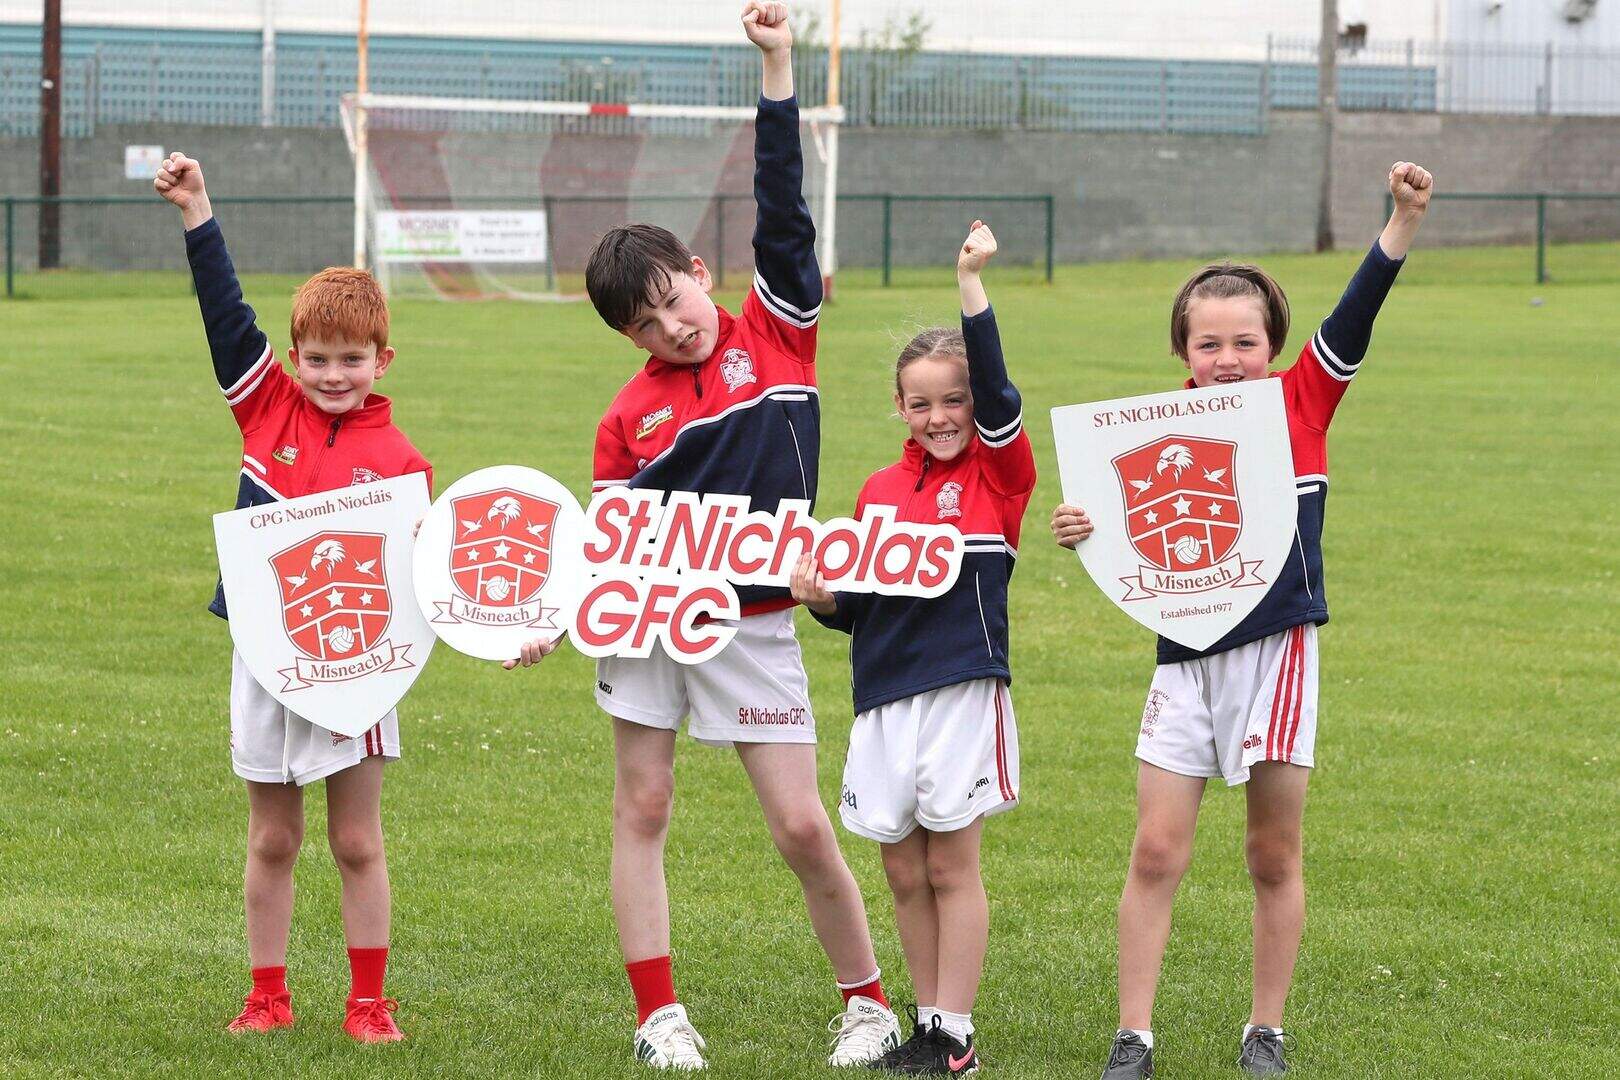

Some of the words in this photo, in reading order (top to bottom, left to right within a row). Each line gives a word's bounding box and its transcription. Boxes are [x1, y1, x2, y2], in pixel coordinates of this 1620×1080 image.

[1093, 411, 1118, 428] ST.
[1119, 399, 1206, 425] NICHOLAS
[1207, 394, 1244, 413] GFC
[250, 510, 284, 529] CPG
[285, 499, 336, 523] Naomh
[337, 489, 393, 512] Niocláis
[1154, 566, 1233, 590] Misneach
[460, 603, 530, 623] Misneach
[575, 580, 730, 655] GFC
[1160, 604, 1212, 620] Established
[1213, 602, 1233, 613] 1977
[310, 652, 384, 679] Misneach
[738, 707, 749, 725] St
[750, 707, 789, 725] Nicholas
[789, 707, 806, 725] GFC
